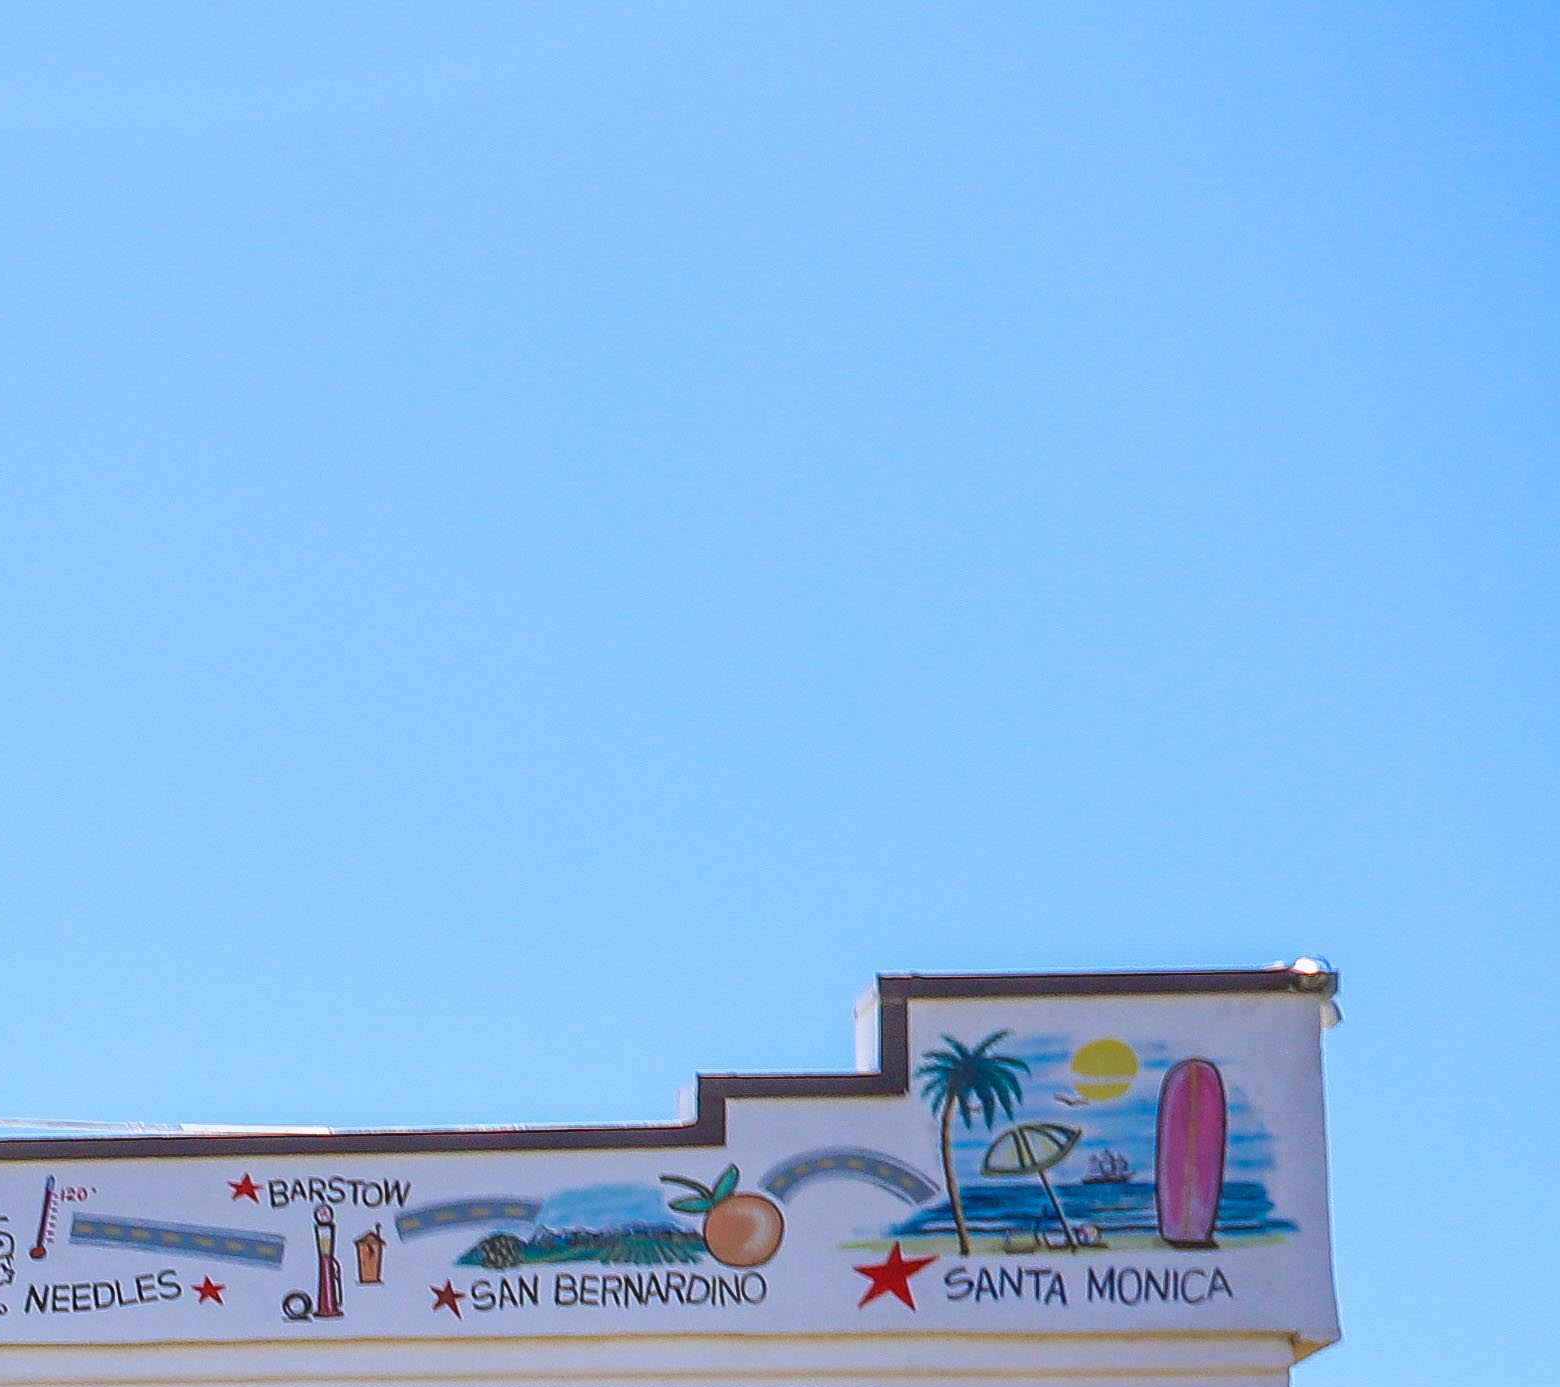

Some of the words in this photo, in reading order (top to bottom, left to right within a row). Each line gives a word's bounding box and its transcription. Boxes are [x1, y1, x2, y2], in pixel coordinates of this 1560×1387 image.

[268, 1176, 412, 1208] BARSTOW
[25, 1270, 182, 1314] NEEDLES
[471, 1273, 540, 1311] SAN
[554, 1272, 767, 1306] BERNARDINO
[944, 1266, 1068, 1306] SANTA
[1088, 1266, 1233, 1305] MONICA
